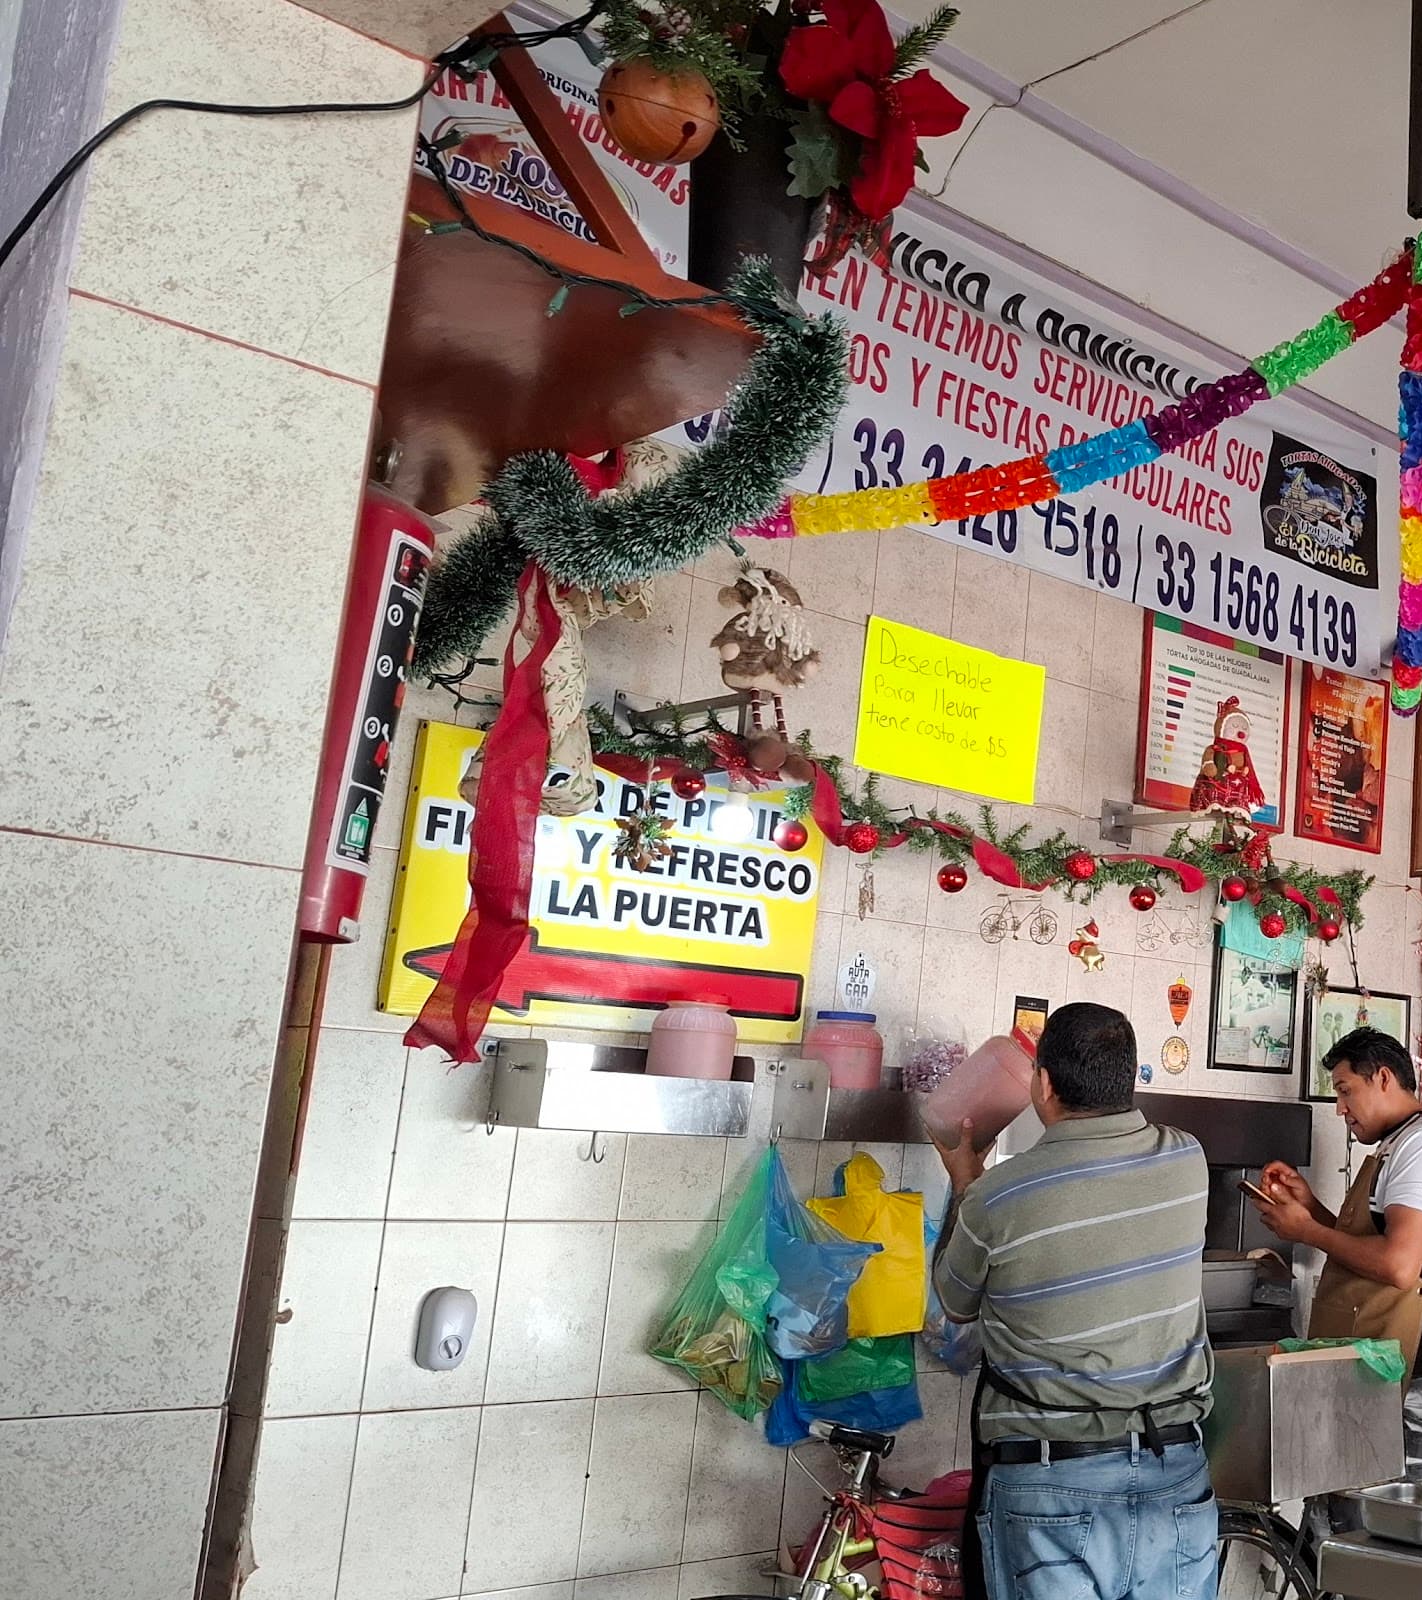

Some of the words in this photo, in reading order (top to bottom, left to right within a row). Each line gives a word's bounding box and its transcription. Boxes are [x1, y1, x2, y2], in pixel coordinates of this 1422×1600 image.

[538, 68, 600, 107] ORIGINA
[502, 148, 570, 198] JOS
[448, 156, 491, 191] DE
[494, 174, 532, 208] LA
[535, 198, 600, 244] BICIC
[1001, 293, 1028, 333] A
[1036, 308, 1214, 400] DOMICILI
[877, 273, 1022, 380] TENEMOS
[1223, 438, 1264, 493] SUS
[911, 356, 932, 408] Y
[937, 370, 1051, 457] FIESTAS
[1059, 422, 1233, 536] PICULARES
[1296, 534, 1368, 576] Bicicleta
[1155, 534, 1197, 613] 33
[1210, 552, 1279, 642] 1568
[1289, 584, 1357, 668] 4139
[880, 627, 992, 692] Desechable
[874, 674, 915, 703] Para
[933, 687, 983, 720] llevar
[865, 703, 910, 731] tiene
[916, 720, 955, 744] costo
[960, 732, 979, 751] de
[986, 736, 1008, 758] $5
[619, 783, 671, 820] DE
[576, 829, 603, 865] Y
[547, 879, 599, 920] LA
[613, 888, 764, 940] PUERTA
[848, 967, 869, 978] RUTA
[854, 958, 865, 968] LA
